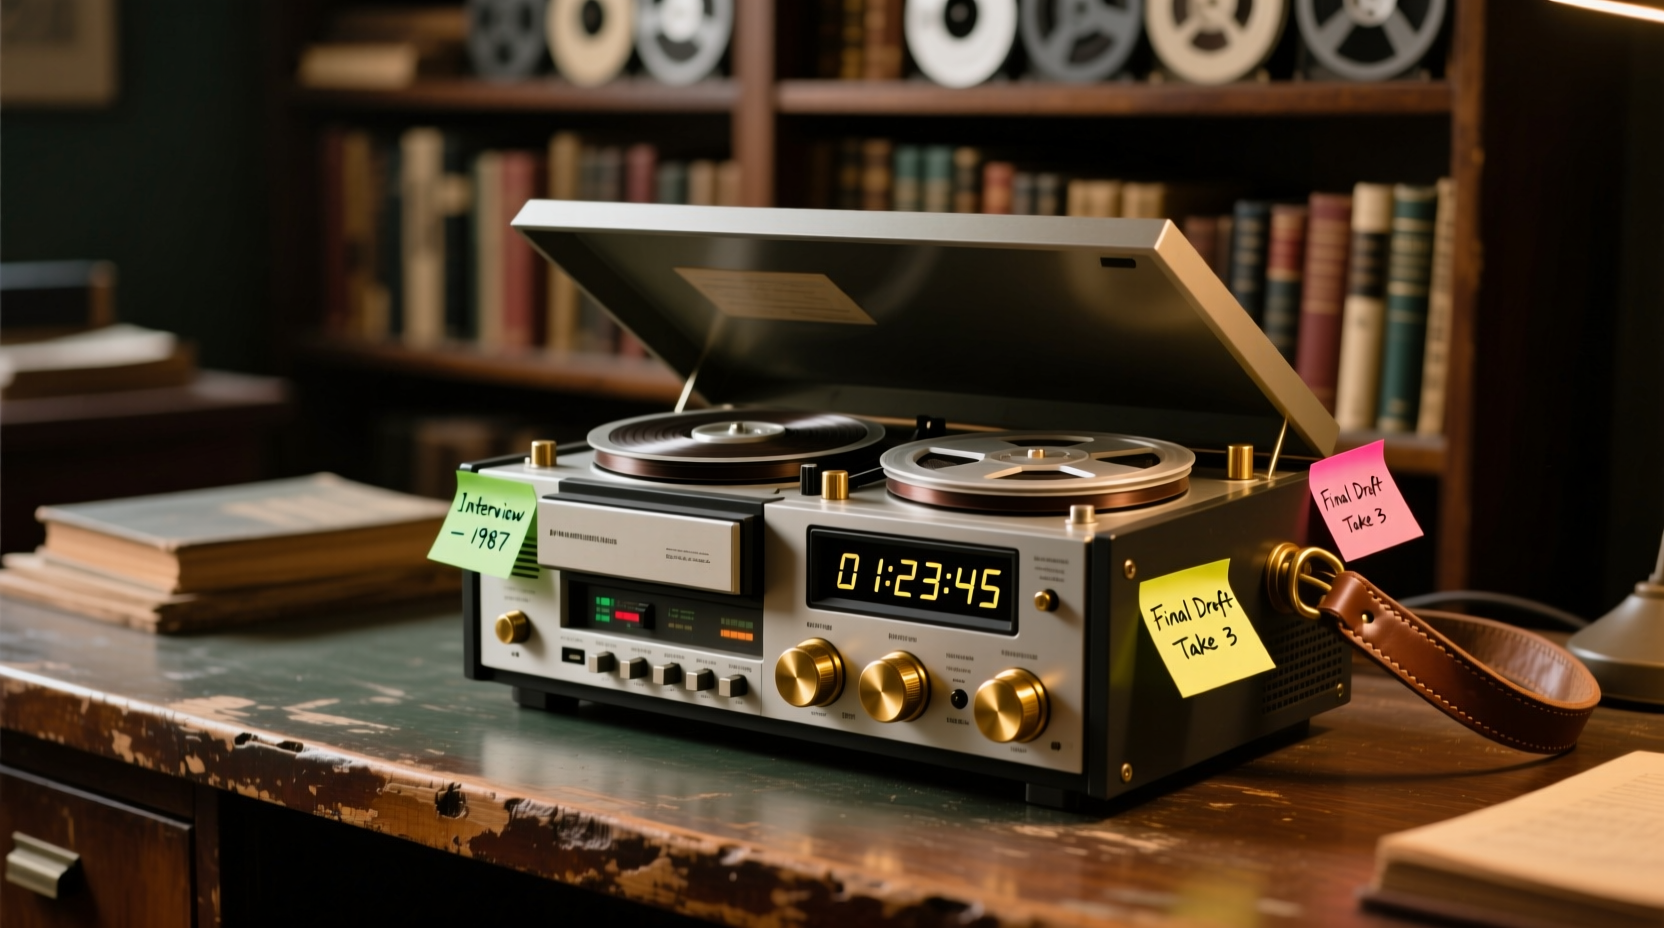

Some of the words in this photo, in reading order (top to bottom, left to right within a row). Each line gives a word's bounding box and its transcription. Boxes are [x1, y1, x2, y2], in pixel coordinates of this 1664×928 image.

[457, 492, 525, 522] Interview
[1320, 485, 1352, 511] Final
[1342, 514, 1374, 534] Take
[1374, 507, 1387, 524] 3
[471, 527, 511, 551] 1987
[836, 552, 1002, 609] 01:23:45
[1150, 599, 1192, 631] Final
[1172, 634, 1219, 660] Take
[1222, 626, 1238, 647] 3
